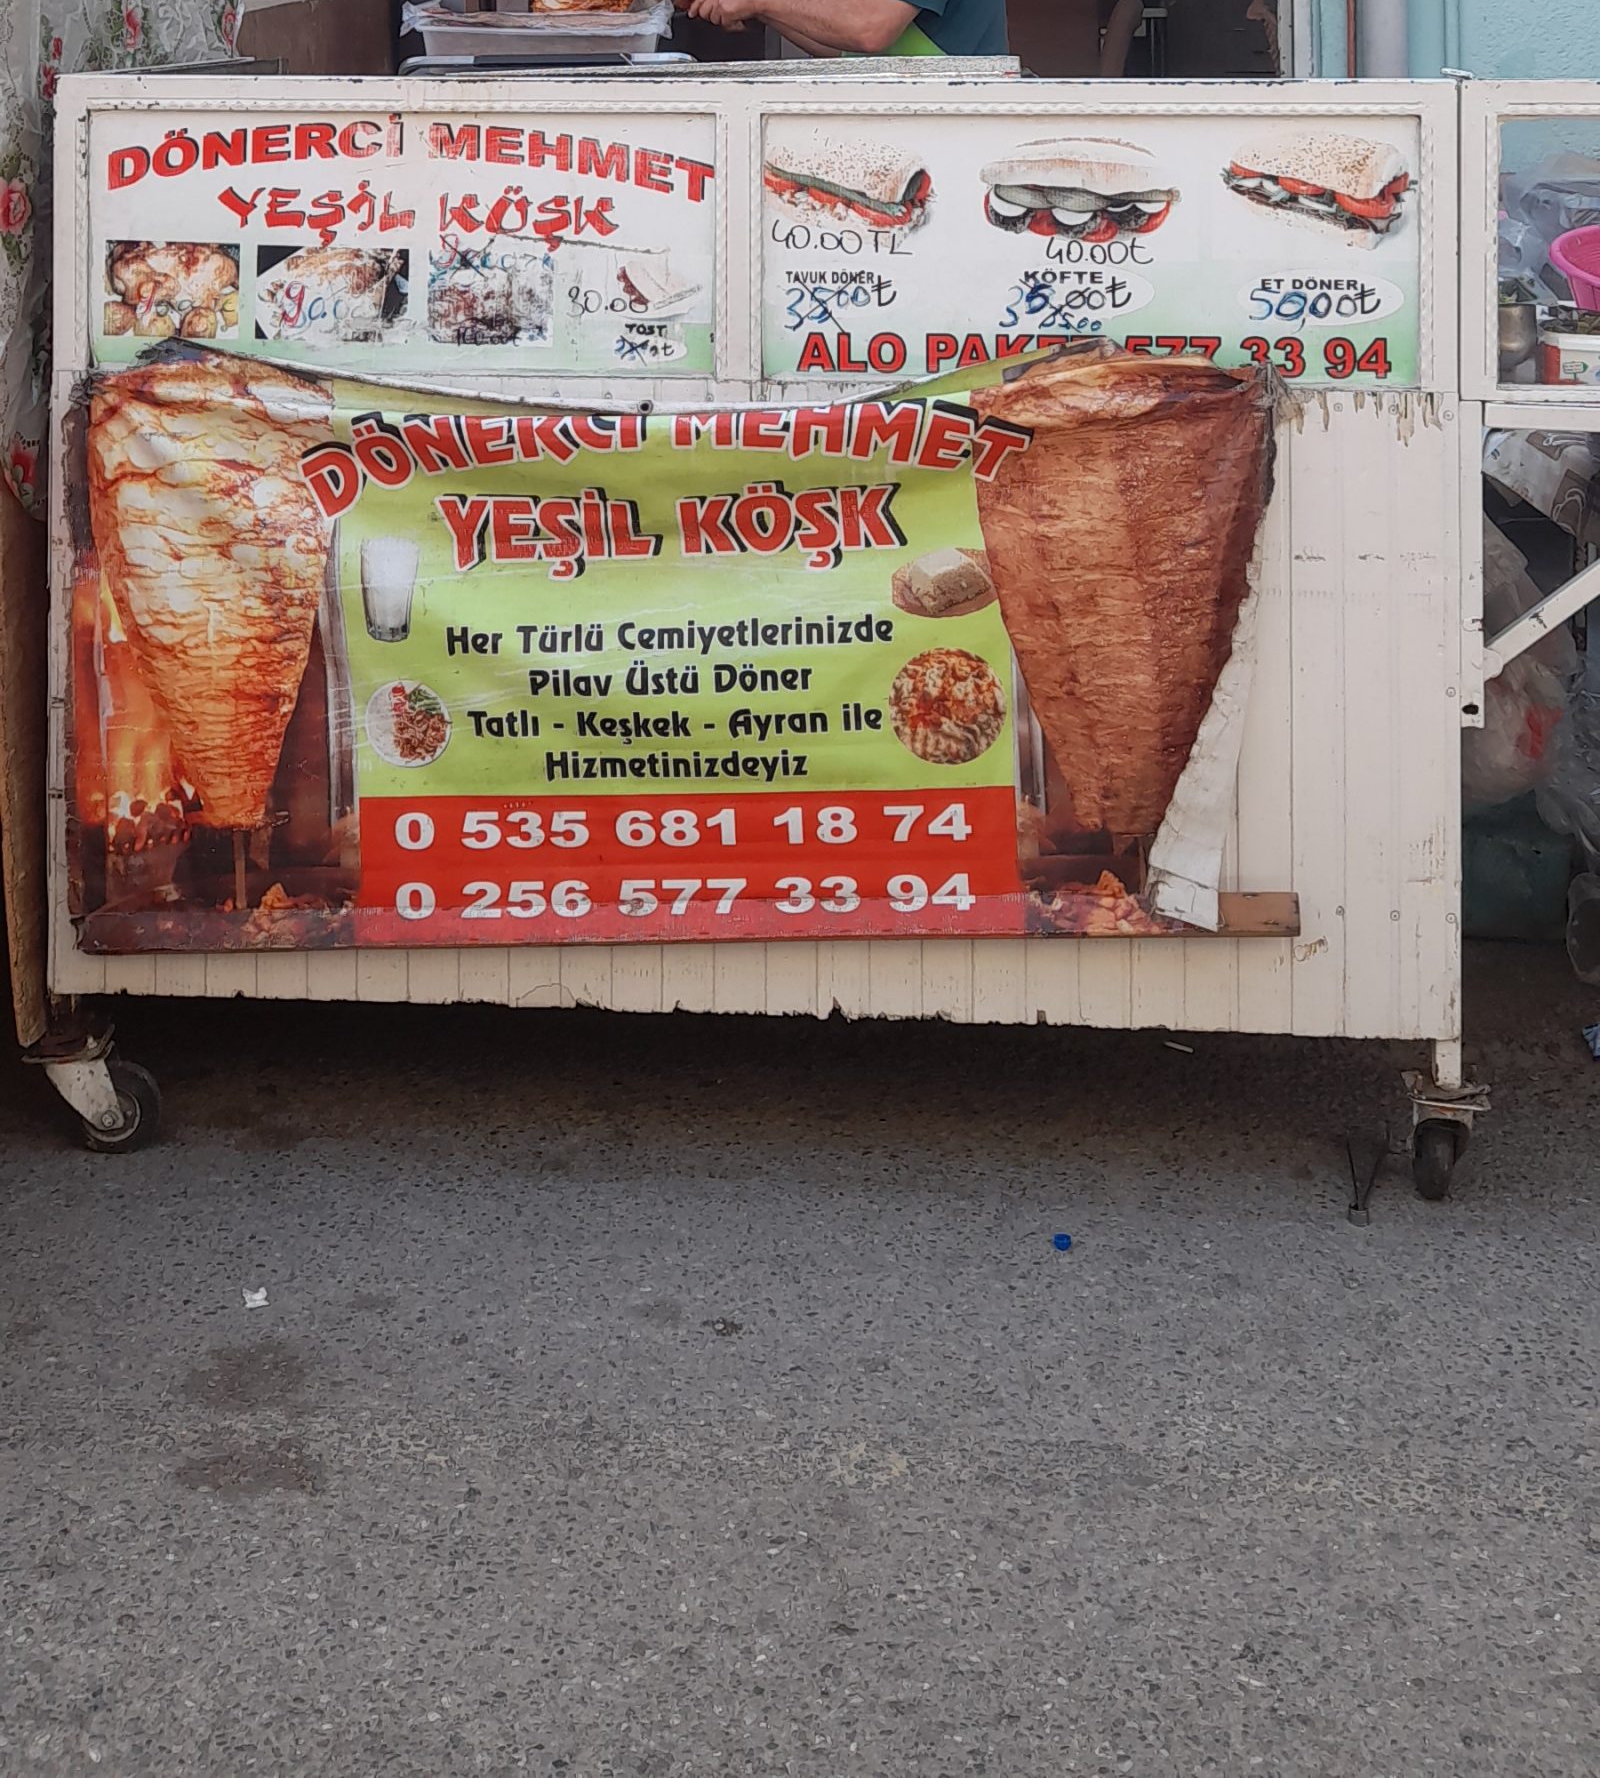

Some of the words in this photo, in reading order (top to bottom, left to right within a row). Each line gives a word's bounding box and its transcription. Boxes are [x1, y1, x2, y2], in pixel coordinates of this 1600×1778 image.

[108, 112, 403, 190] DÖNERCİ
[428, 123, 715, 203] MEHMET
[218, 180, 416, 248] YEŞİL
[439, 185, 619, 252] KÖŞK
[785, 271, 827, 284] TAVUK
[832, 268, 875, 284] DÖNER
[1024, 268, 1104, 284] KÖFTE
[1260, 278, 1285, 290] ET
[1292, 276, 1358, 290] DÖNER
[624, 323, 668, 337] TOST
[797, 332, 907, 373] ALO
[925, 333, 1106, 372] PAK
[1240, 335, 1306, 379] 33
[1324, 336, 1392, 380] 94
[671, 398, 1034, 482] MEHMET
[436, 486, 663, 580] YEŞİL
[676, 480, 907, 572] KÖŞK
[446, 626, 503, 656] Her
[516, 623, 604, 654] Türlü
[617, 613, 893, 655] Cemiyetlerinizde
[529, 669, 612, 697] Pilav
[625, 660, 699, 695] Üstü
[714, 663, 812, 694] Döner
[467, 710, 540, 737] Tatlı
[576, 711, 691, 745] Keşkek
[728, 708, 828, 741] Ayran
[842, 702, 882, 731] ile
[546, 749, 808, 783] Hizmetinizdeyiz
[394, 812, 435, 850] 0
[460, 810, 591, 849] 535
[614, 807, 737, 847] 681
[772, 805, 858, 845] 18
[882, 803, 972, 842] 74
[395, 882, 436, 920] 0
[459, 879, 592, 919] 256
[616, 877, 748, 917] 577
[773, 875, 861, 913] 33
[886, 873, 976, 912] 94
